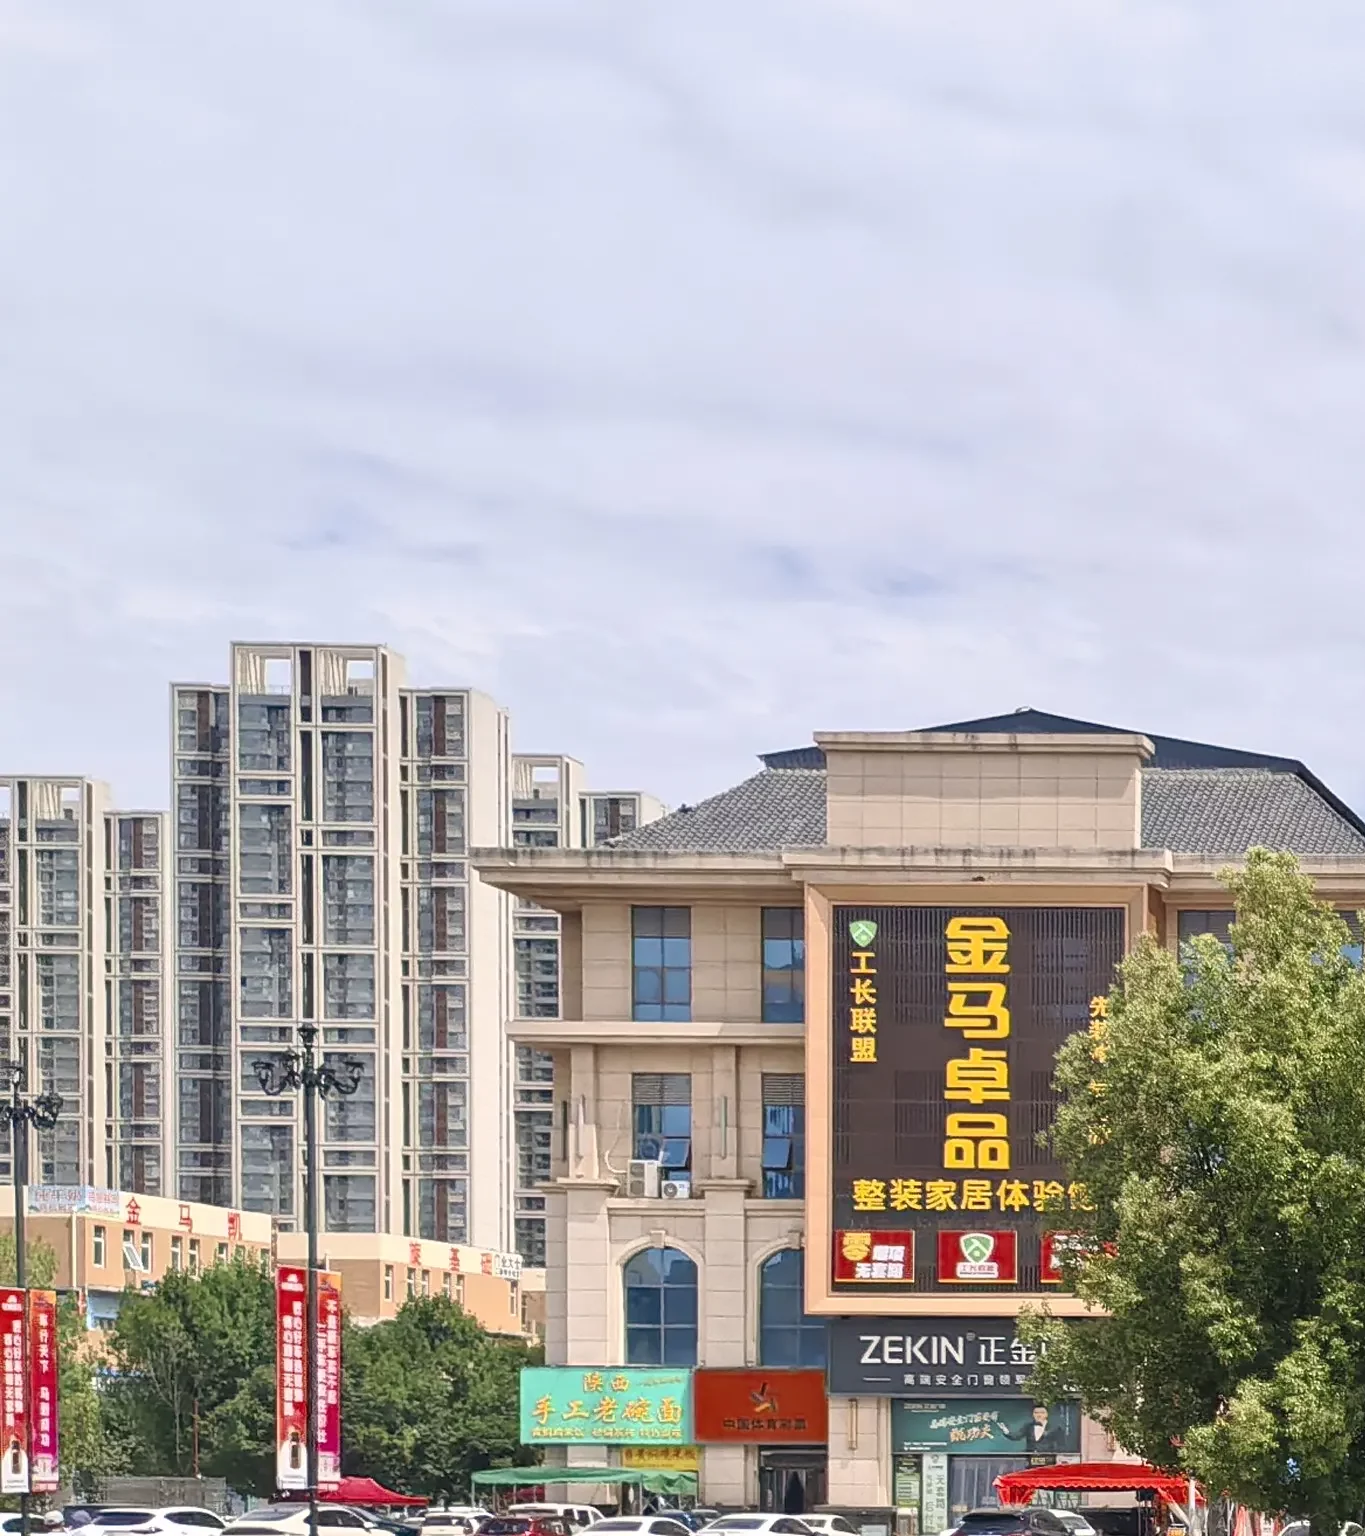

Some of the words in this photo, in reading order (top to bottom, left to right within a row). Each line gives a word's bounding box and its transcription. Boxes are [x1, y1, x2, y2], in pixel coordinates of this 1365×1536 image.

[849, 952, 877, 1064] 工长联盟
[944, 916, 1011, 1171] 金马卓品
[859, 1335, 965, 1365] ZEKIN
[583, 1371, 630, 1393] 陕西
[531, 1393, 683, 1425] 手工老碗面
